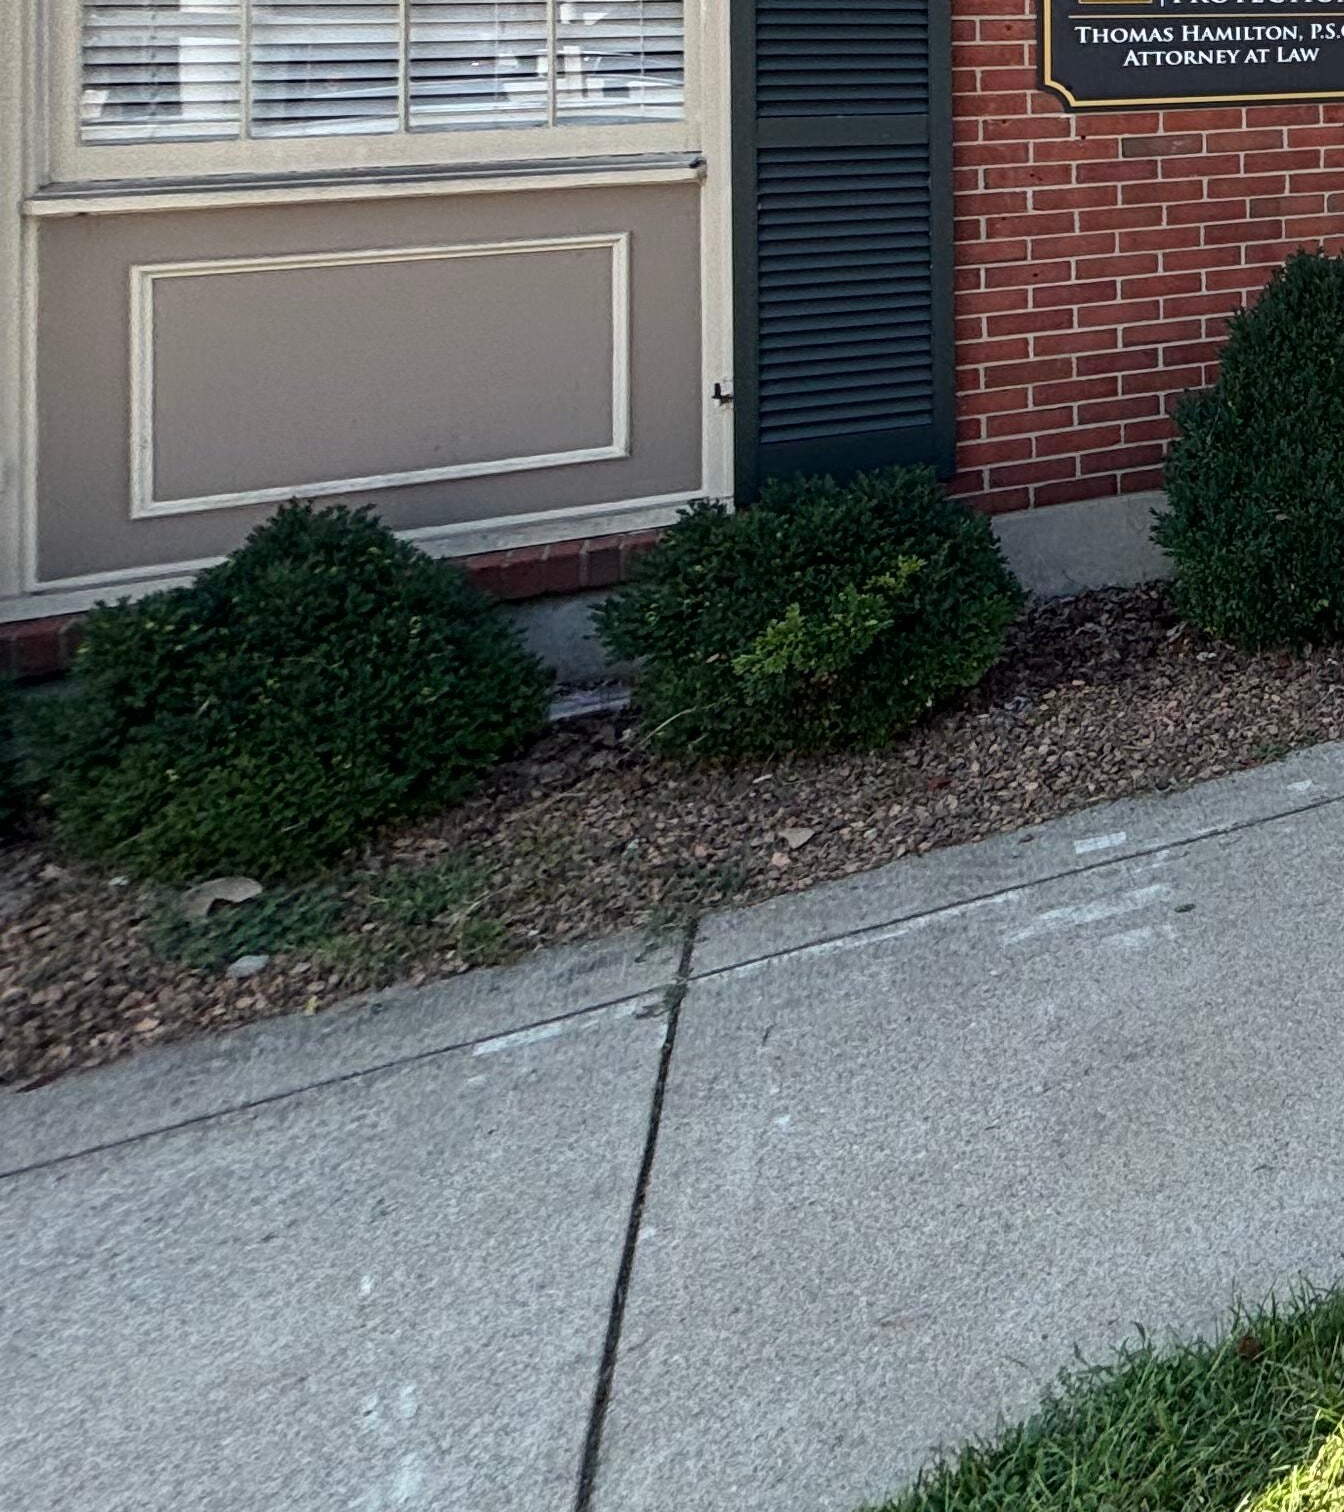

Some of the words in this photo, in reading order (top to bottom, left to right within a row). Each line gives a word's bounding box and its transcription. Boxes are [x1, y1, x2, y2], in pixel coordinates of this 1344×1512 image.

[1074, 25, 1174, 44] THOMAS
[1181, 24, 1304, 42] HAMILTON,
[1122, 49, 1241, 67] ATTORNEY
[1243, 48, 1271, 64] AT
[1277, 46, 1320, 63] LAW
